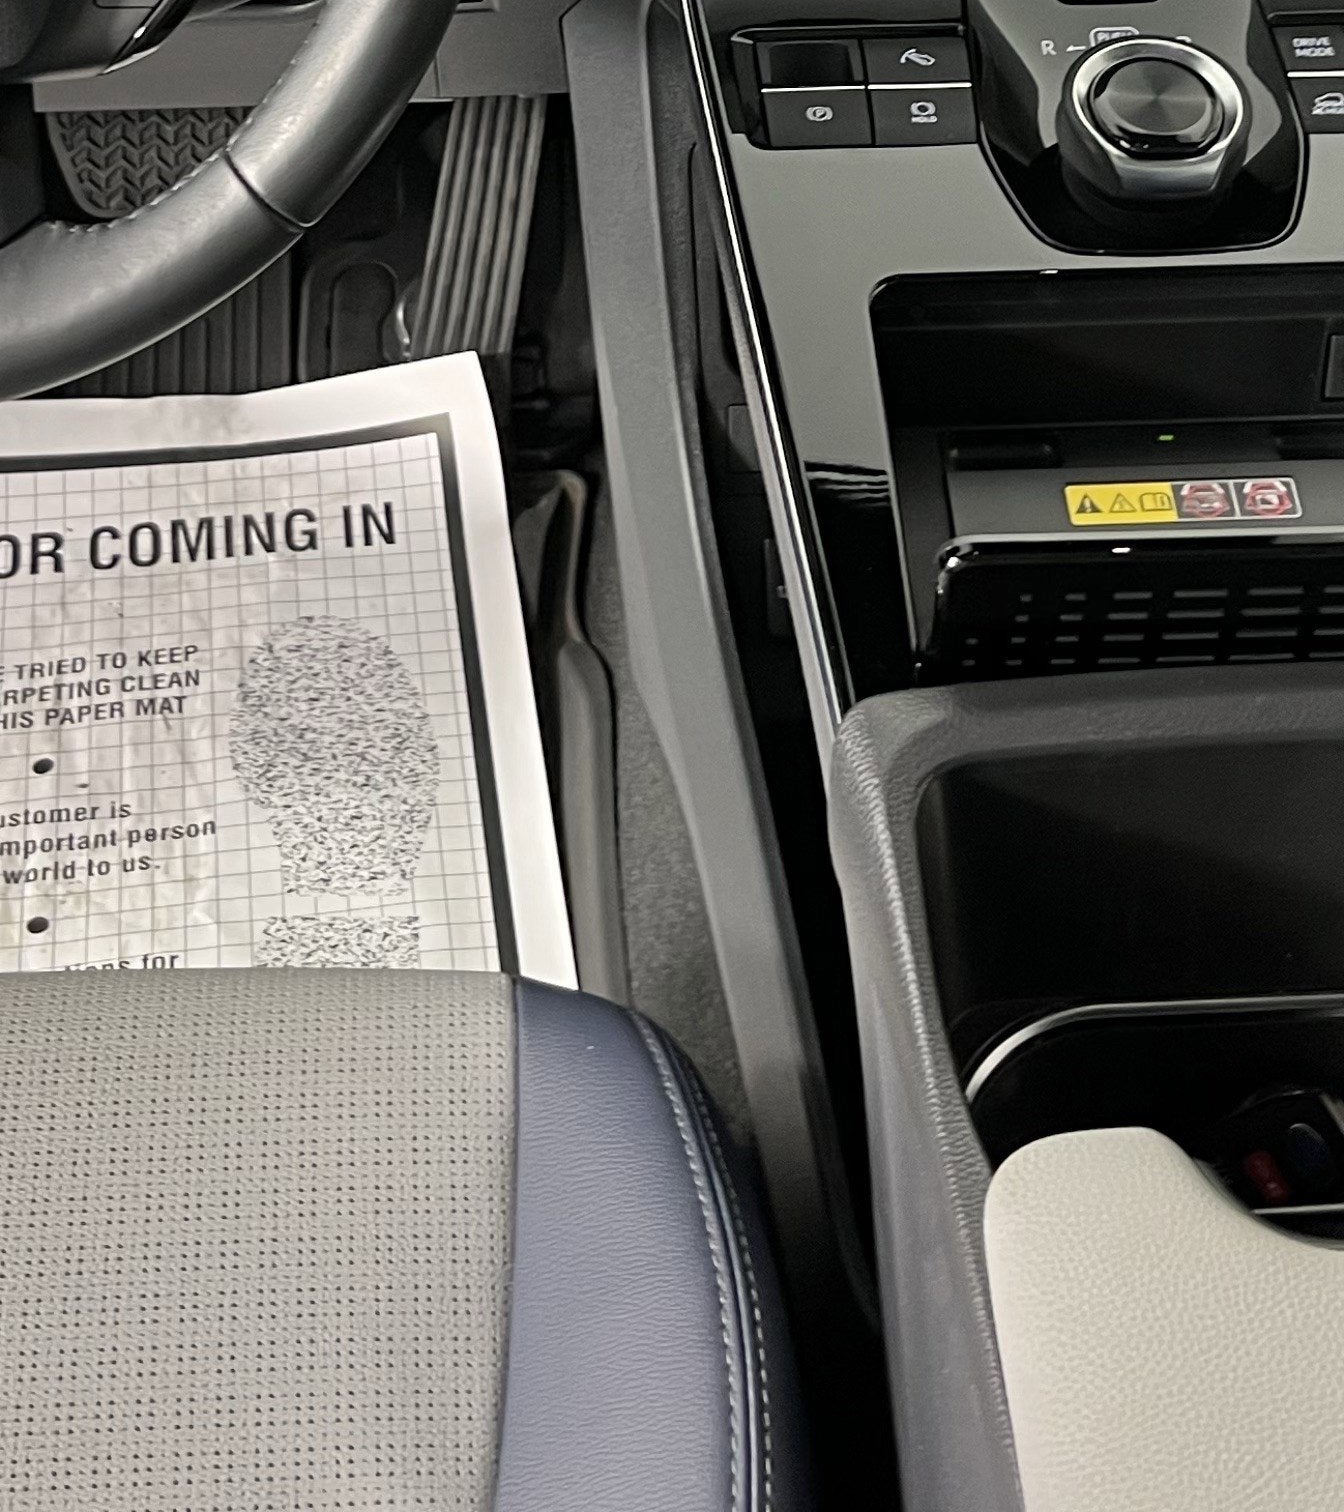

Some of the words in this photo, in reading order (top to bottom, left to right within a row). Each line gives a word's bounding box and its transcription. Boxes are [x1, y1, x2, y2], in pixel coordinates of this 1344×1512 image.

[1040, 40, 1058, 56] R
[89, 507, 320, 572] COMING
[341, 500, 398, 549] IN
[12, 656, 87, 681] TRIED
[96, 651, 128, 671] TO
[136, 644, 199, 668] KEEP
[119, 668, 202, 694] CLEAN
[44, 700, 125, 727] PAPER
[133, 695, 188, 718] MAT
[110, 800, 133, 820] is
[126, 819, 218, 848] person
[3, 860, 77, 886] world
[86, 858, 112, 878] to
[121, 853, 162, 874] us.
[142, 951, 180, 970] for
